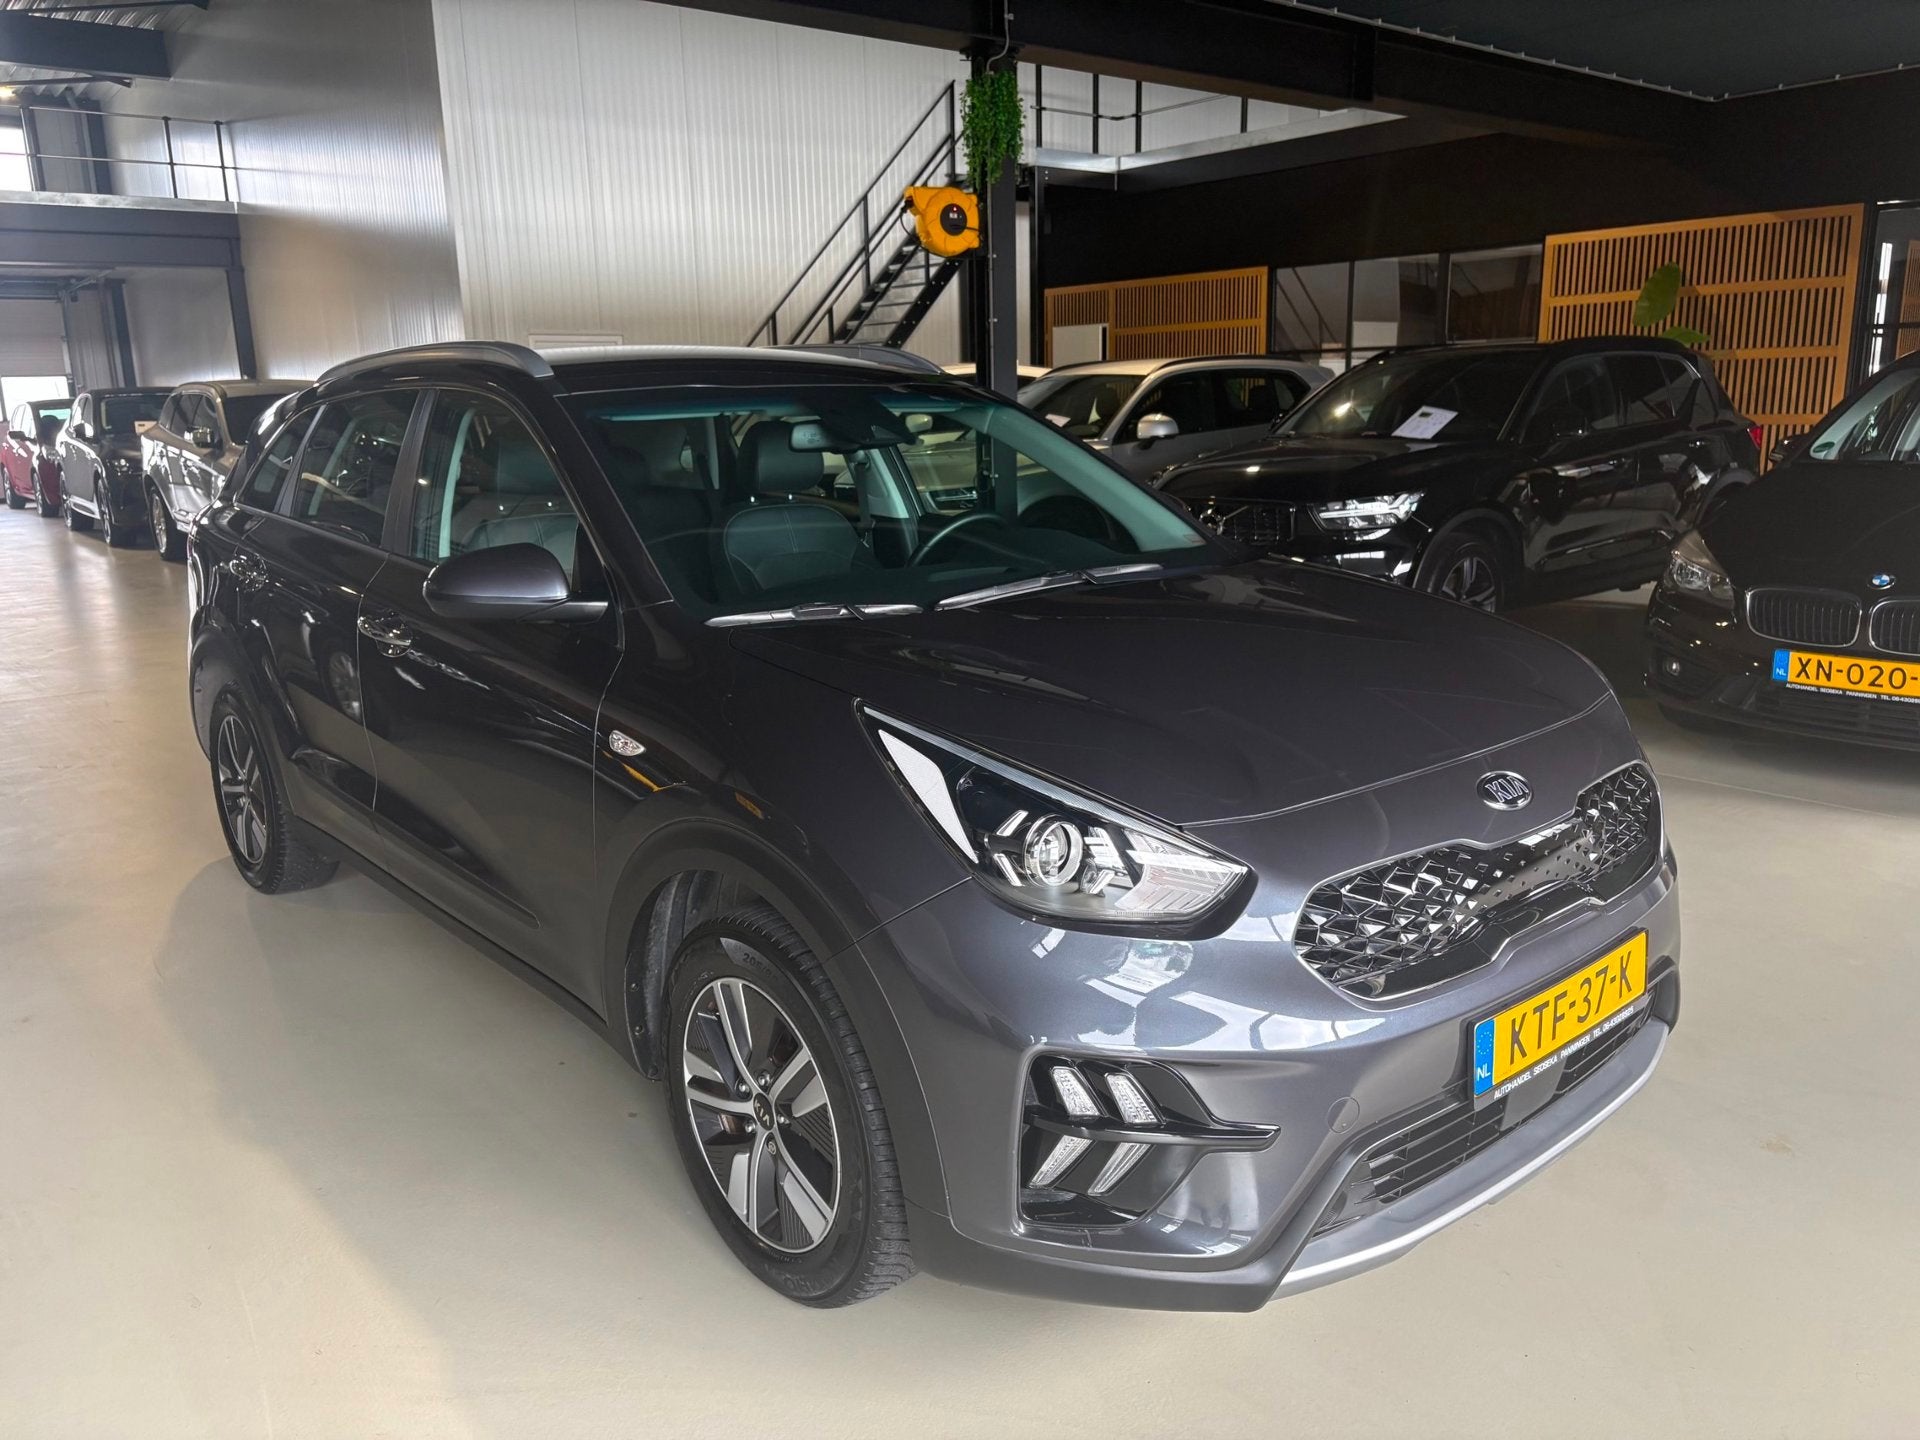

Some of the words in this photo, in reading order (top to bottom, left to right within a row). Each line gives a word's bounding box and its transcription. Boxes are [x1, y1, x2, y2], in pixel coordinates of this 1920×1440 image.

[1775, 668, 1787, 677] NL
[1785, 682, 1818, 692] AUTOHANDEL
[1845, 691, 1877, 699] PANNINGEN
[1485, 776, 1529, 803] KIA
[1509, 950, 1632, 1065] KTF-37-K
[1477, 1063, 1491, 1081] NL
[1494, 1071, 1532, 1100] AUTOHANDEL
[1561, 1034, 1591, 1059] PANNINGEN
[754, 1099, 770, 1126] KIA
